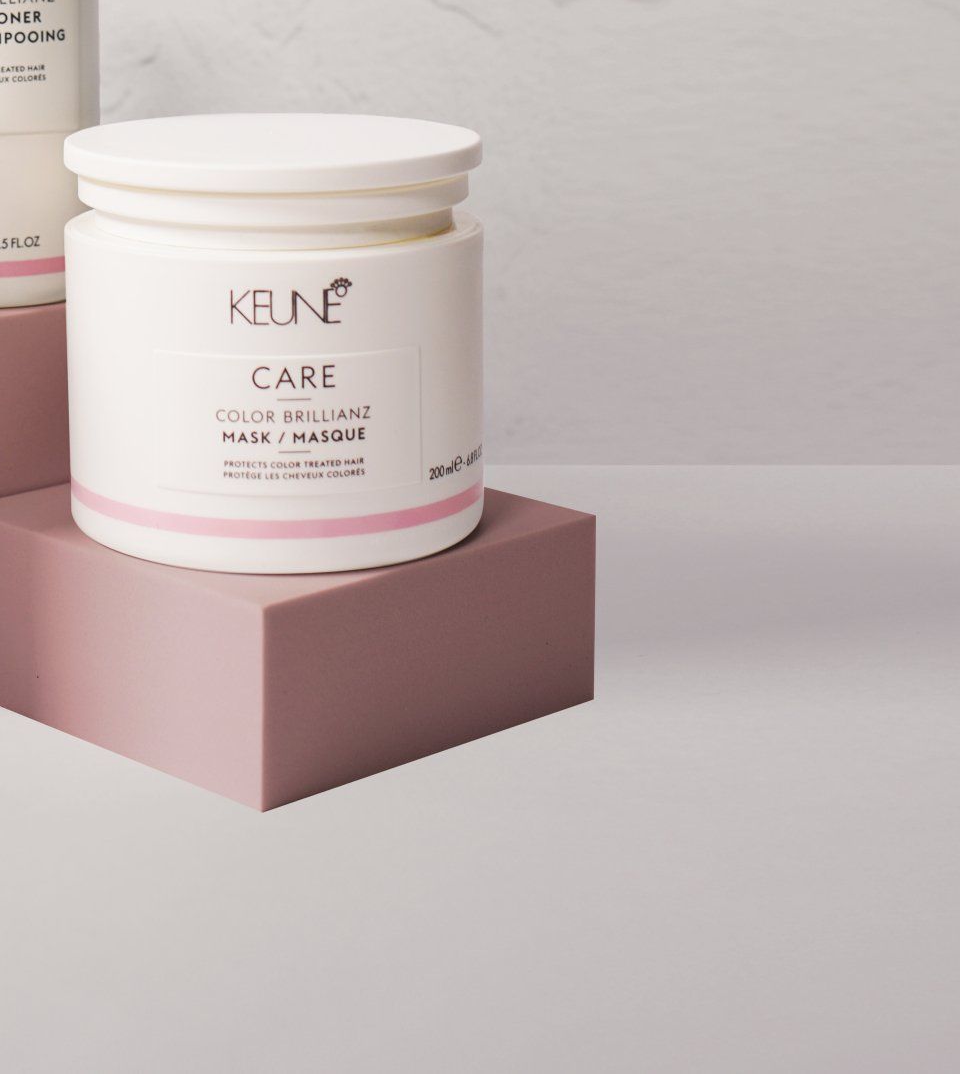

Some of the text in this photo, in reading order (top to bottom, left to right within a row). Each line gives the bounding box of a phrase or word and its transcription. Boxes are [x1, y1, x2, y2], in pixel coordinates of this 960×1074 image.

[28, 64, 45, 72] HAIR
[12, 74, 46, 83] COLORÉS
[11, 236, 40, 248] FL.OZ
[230, 288, 342, 326] KEUNE
[252, 364, 336, 390] CARE
[216, 405, 371, 423] COLOR BRILLIANZ
[222, 428, 366, 444] MASK / MASQUE
[224, 457, 365, 469] PROTECTS COLOR TREATED HAIR
[265, 472, 280, 480] LES
[282, 471, 324, 480] CHEVEUX
[327, 468, 366, 478] COLORÉS
[429, 465, 444, 480] 200
